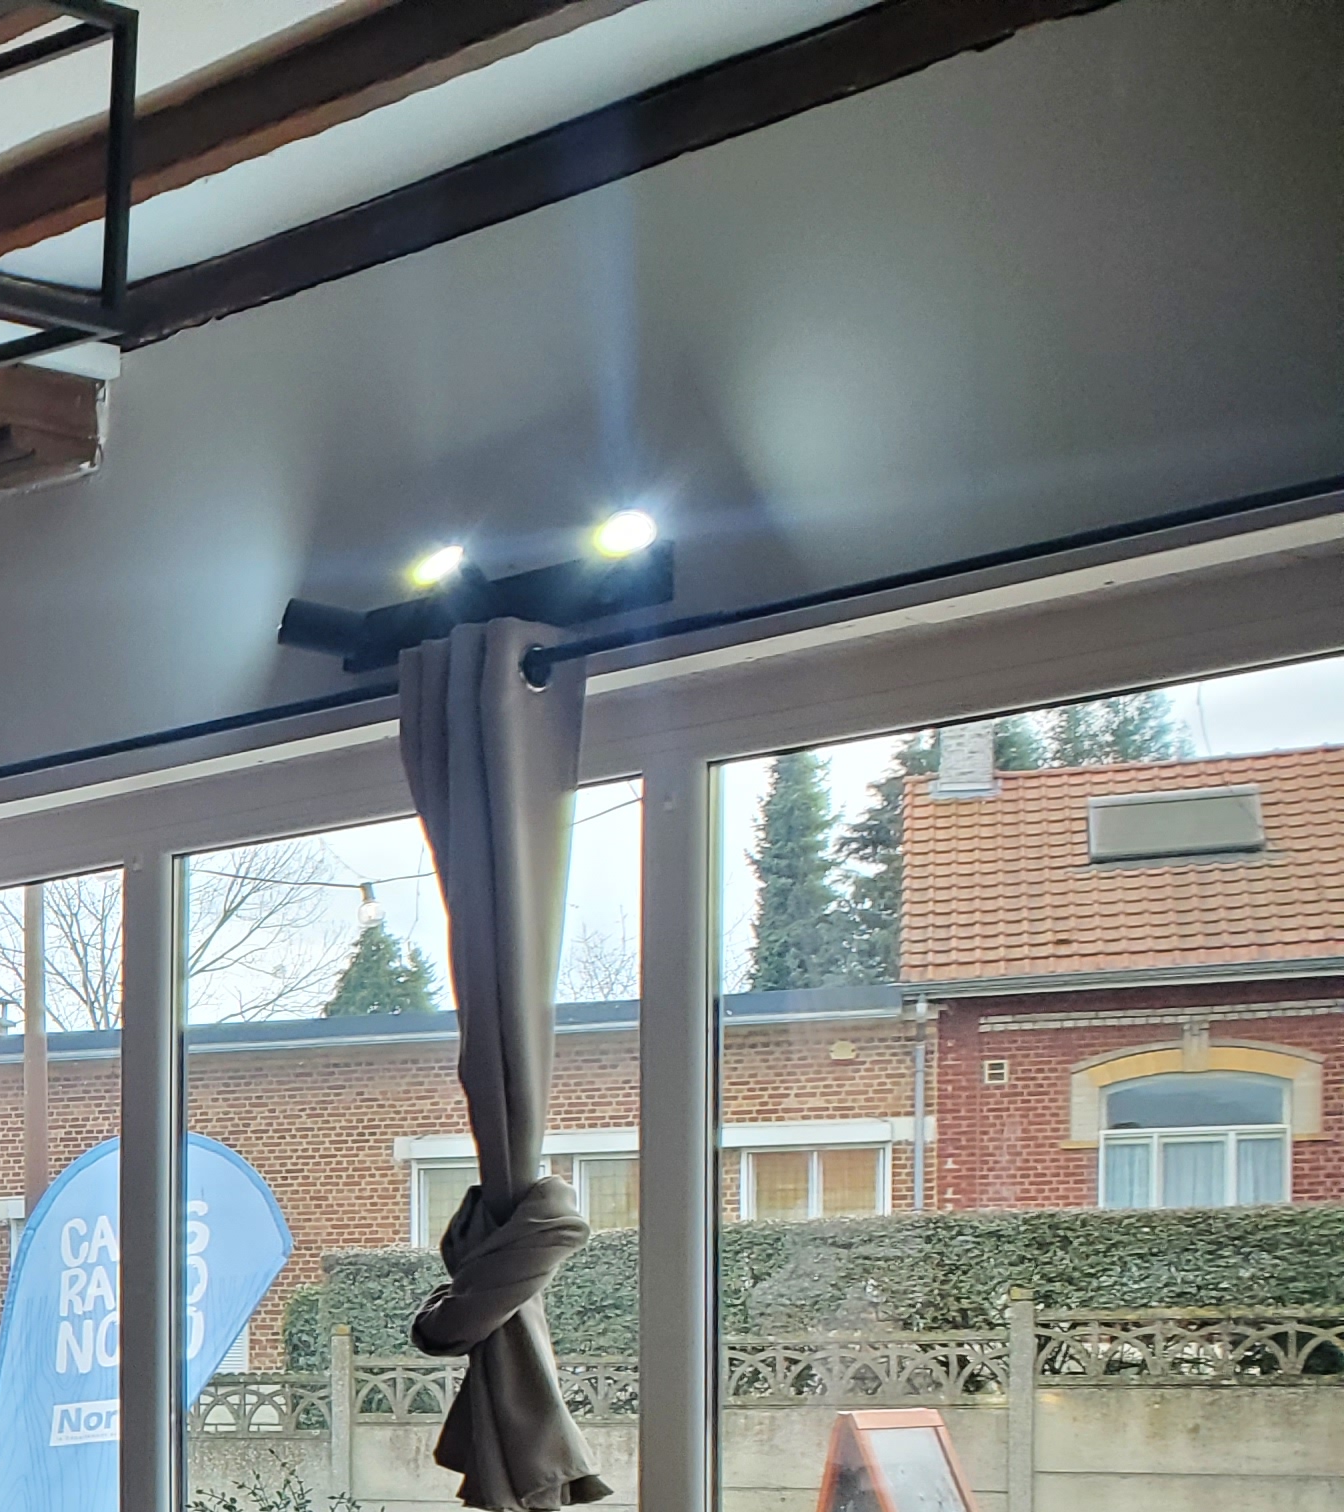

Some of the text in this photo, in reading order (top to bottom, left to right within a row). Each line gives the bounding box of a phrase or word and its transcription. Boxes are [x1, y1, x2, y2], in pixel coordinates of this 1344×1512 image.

[60, 1200, 210, 1268] CAS
[59, 1255, 208, 1316] RAO
[55, 1306, 205, 1374] NOD
[58, 1407, 119, 1433] Nor
